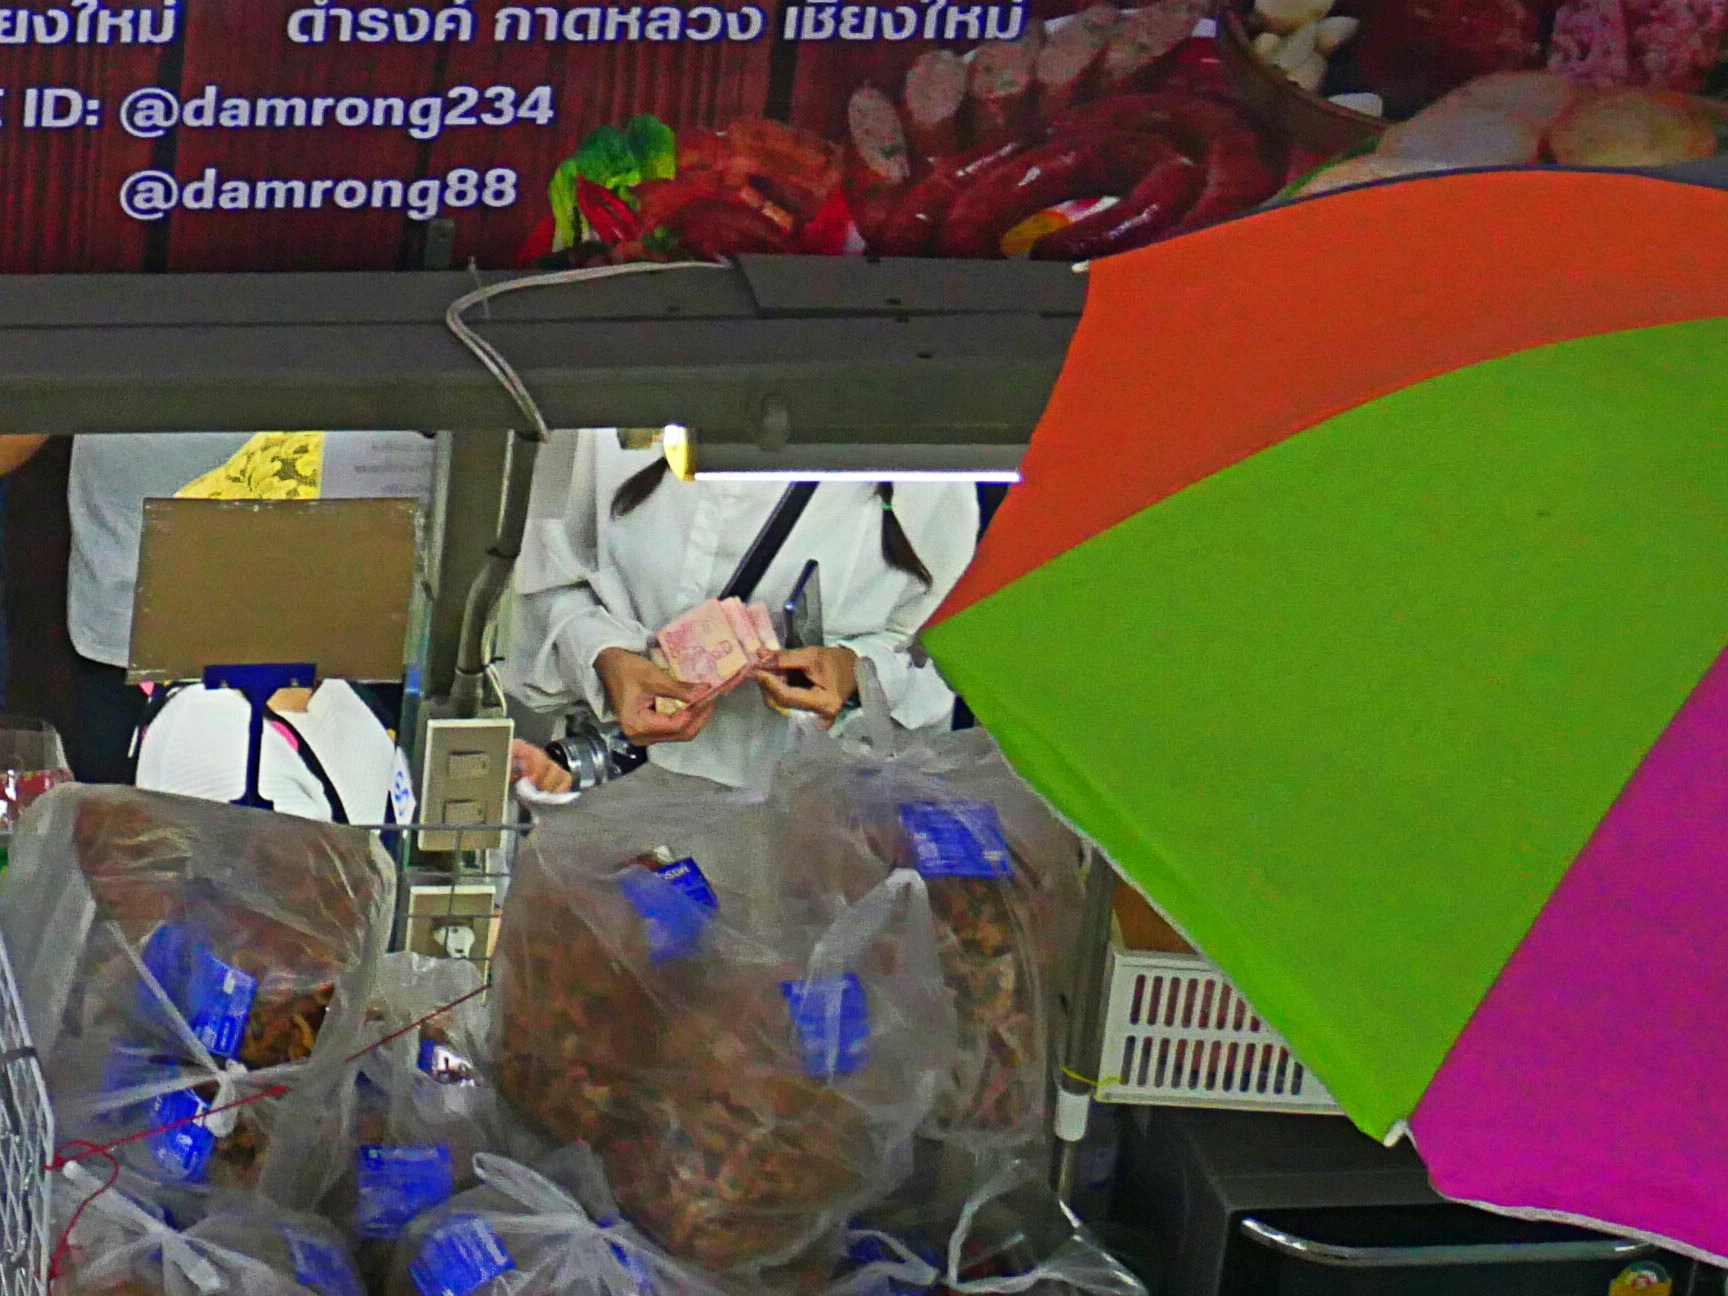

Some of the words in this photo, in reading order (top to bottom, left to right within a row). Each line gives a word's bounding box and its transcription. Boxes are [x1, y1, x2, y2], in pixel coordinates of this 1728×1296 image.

[493, 0, 764, 44] กาดหลวง
[23, 88, 101, 130] ID:
[118, 83, 555, 141] @damrong234
[118, 167, 519, 223] @damrong88
